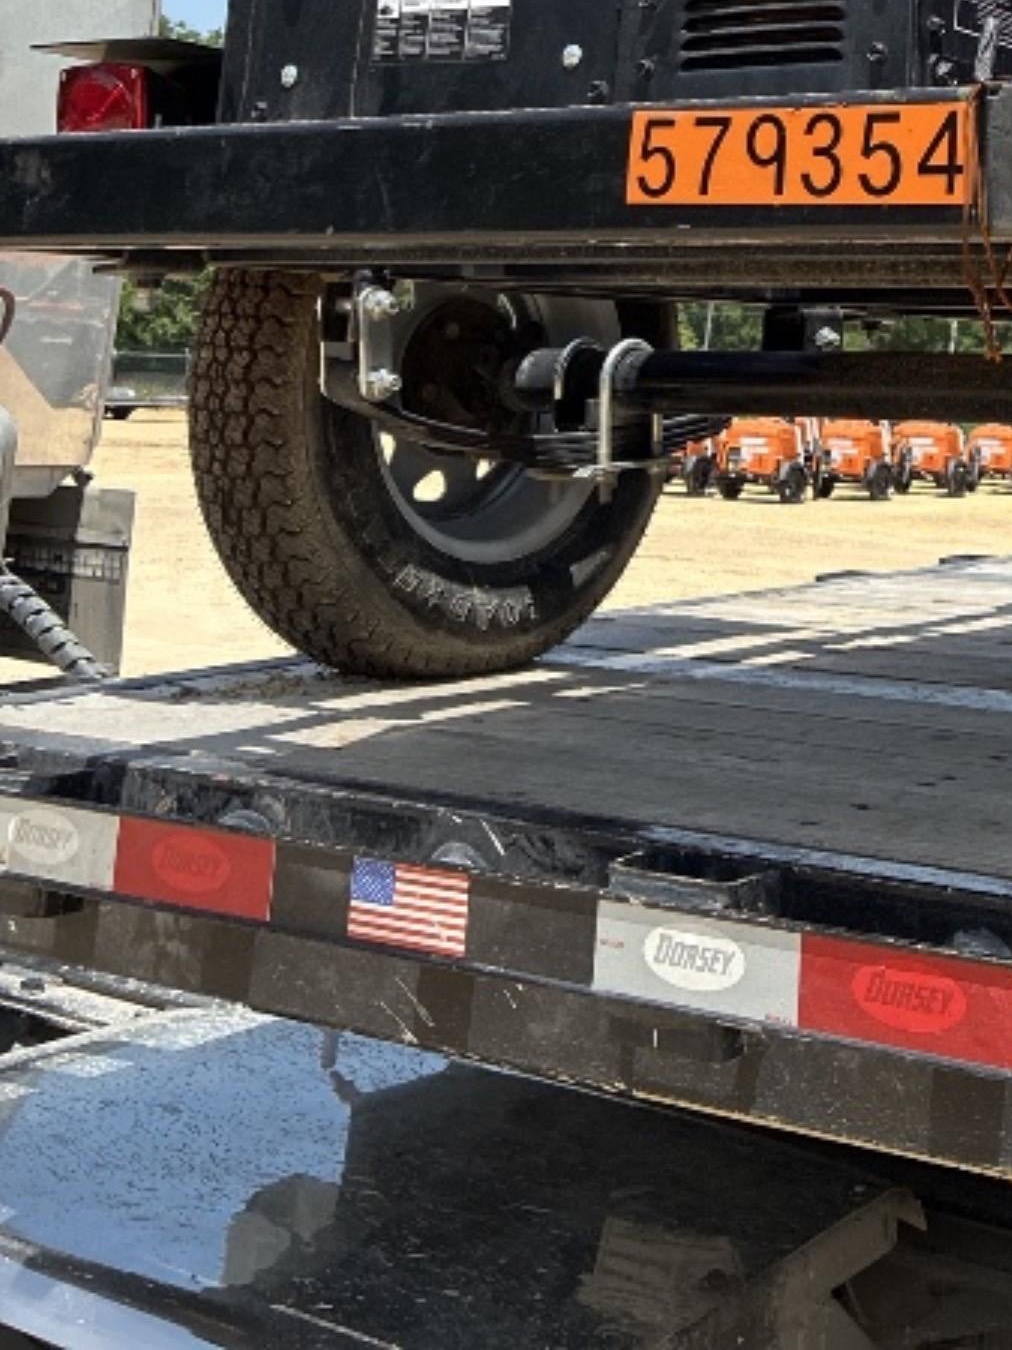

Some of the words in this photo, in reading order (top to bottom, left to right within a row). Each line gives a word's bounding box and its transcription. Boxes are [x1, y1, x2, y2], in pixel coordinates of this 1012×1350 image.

[636, 109, 965, 199] 579354
[653, 932, 736, 977] DORSEY
[863, 971, 953, 1017] DORSEY
